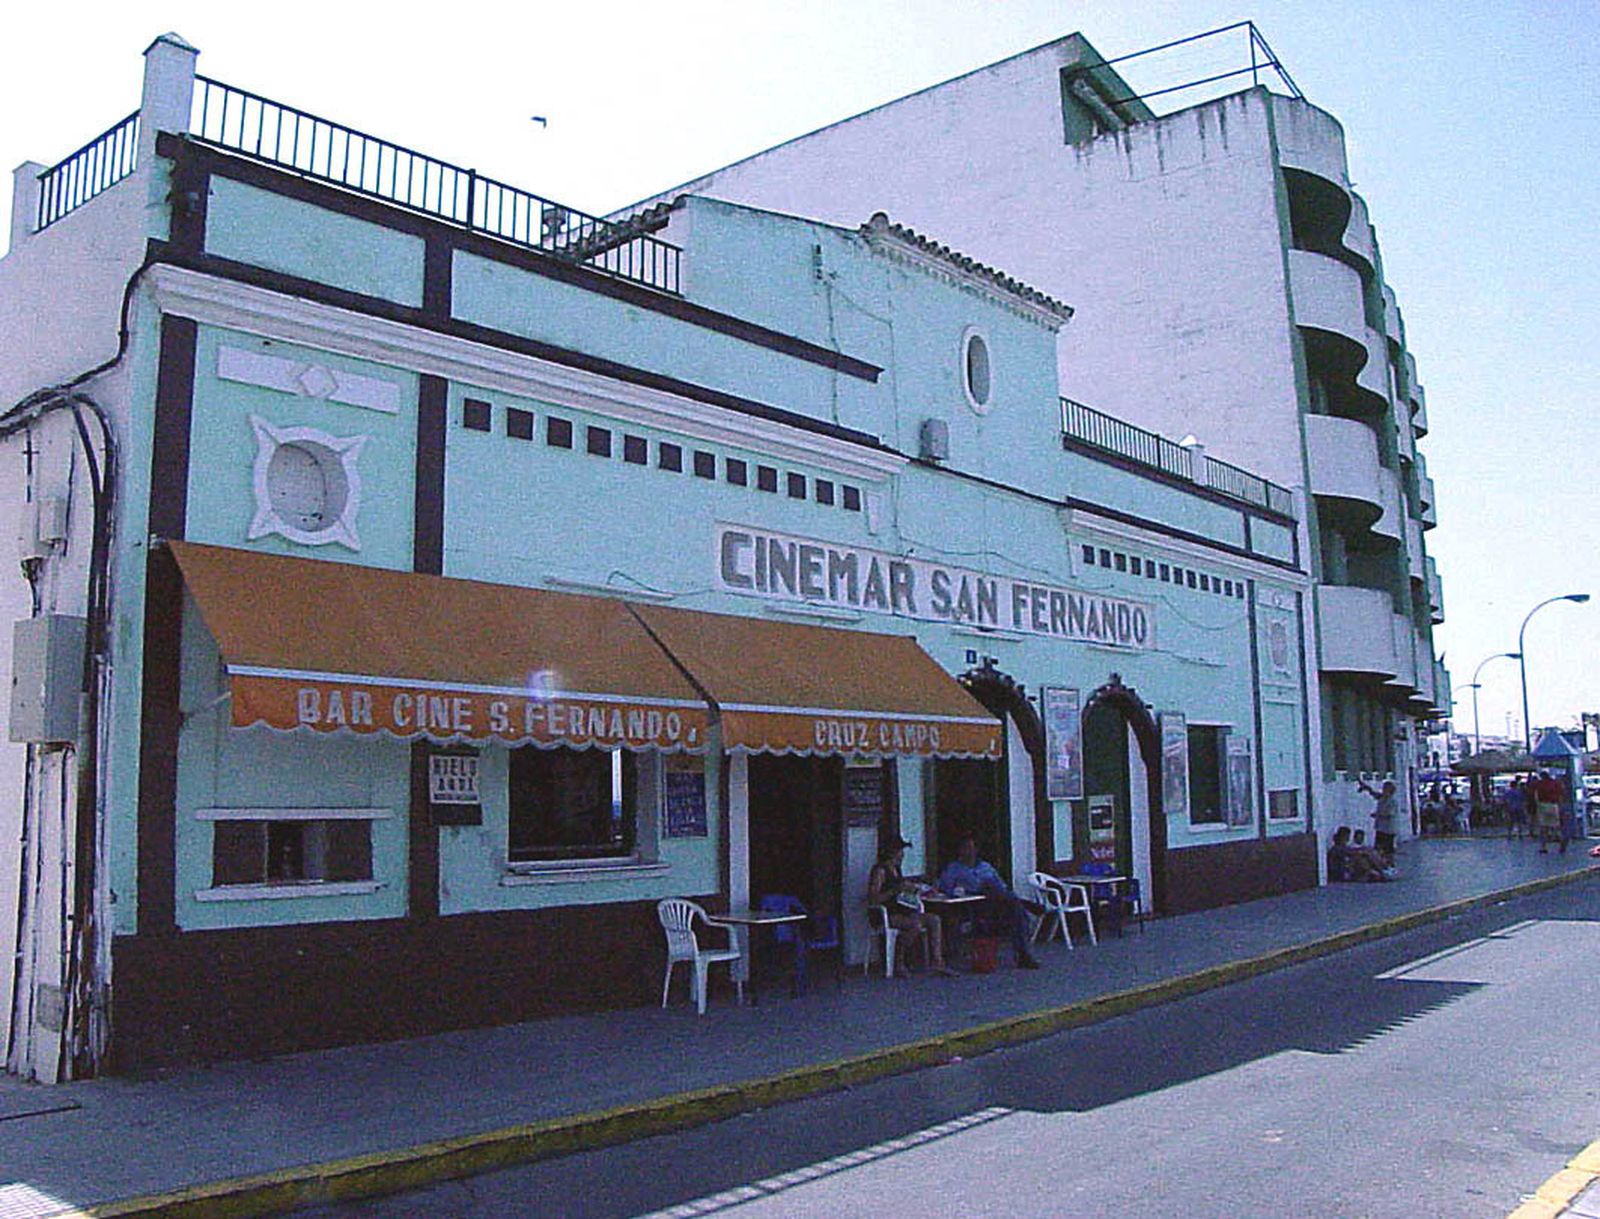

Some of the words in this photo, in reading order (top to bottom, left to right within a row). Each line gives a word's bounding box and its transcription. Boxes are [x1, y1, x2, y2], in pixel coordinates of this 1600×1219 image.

[720, 530, 917, 615] CINEMAR
[930, 568, 999, 627] SAN
[1011, 582, 1149, 645] FERNANDO
[297, 686, 373, 726] BAR
[392, 695, 473, 733] CINE
[525, 704, 683, 741] FERNANDO
[814, 720, 869, 747] CRUZ
[879, 723, 941, 750] CAMPO
